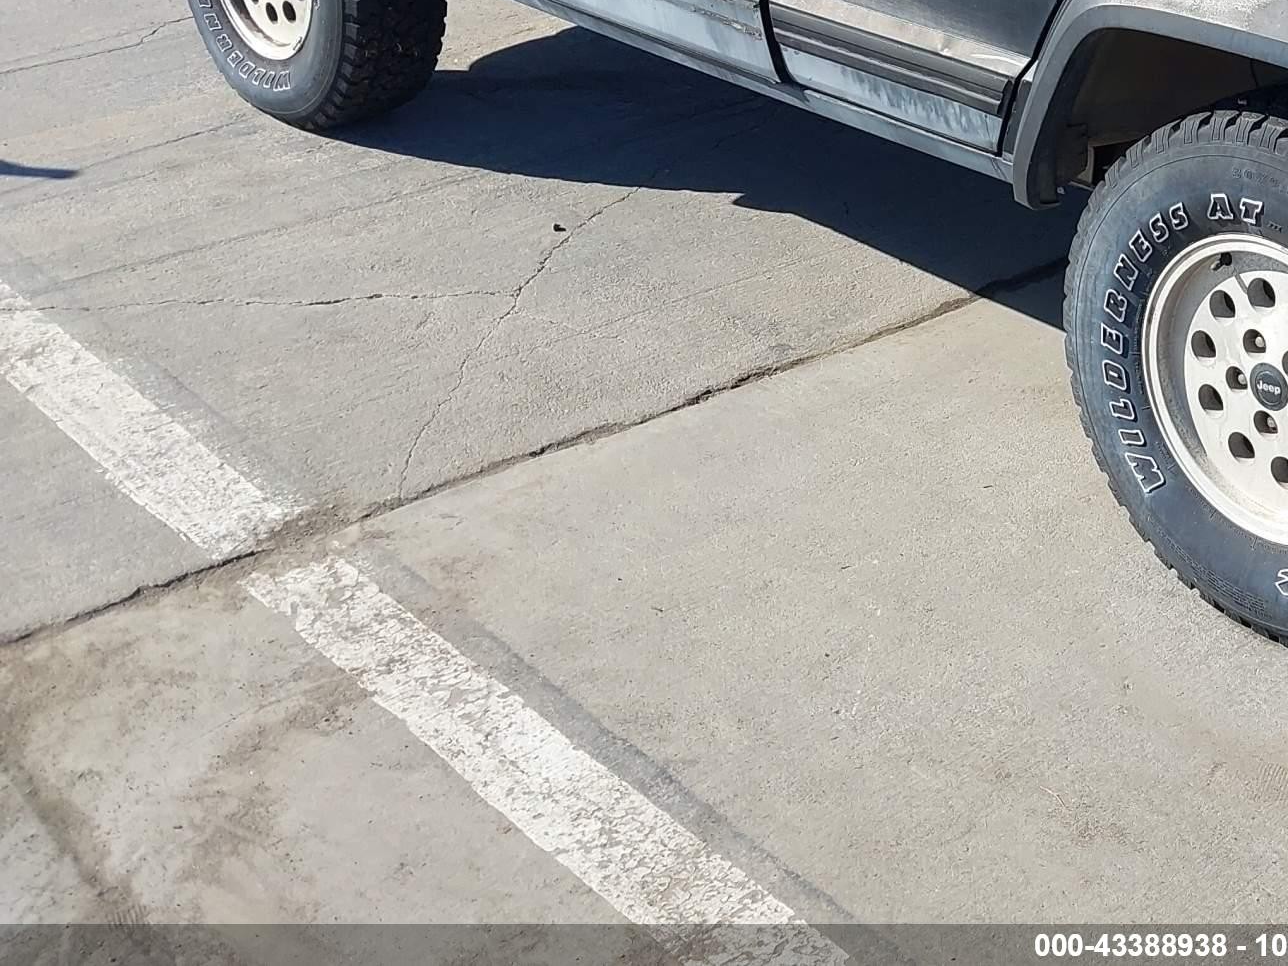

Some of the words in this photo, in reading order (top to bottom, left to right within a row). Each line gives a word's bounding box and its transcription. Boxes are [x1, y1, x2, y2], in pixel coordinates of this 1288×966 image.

[1099, 201, 1190, 494] WILDERNESS
[1206, 192, 1264, 226] AT
[1256, 379, 1281, 396] Jeep
